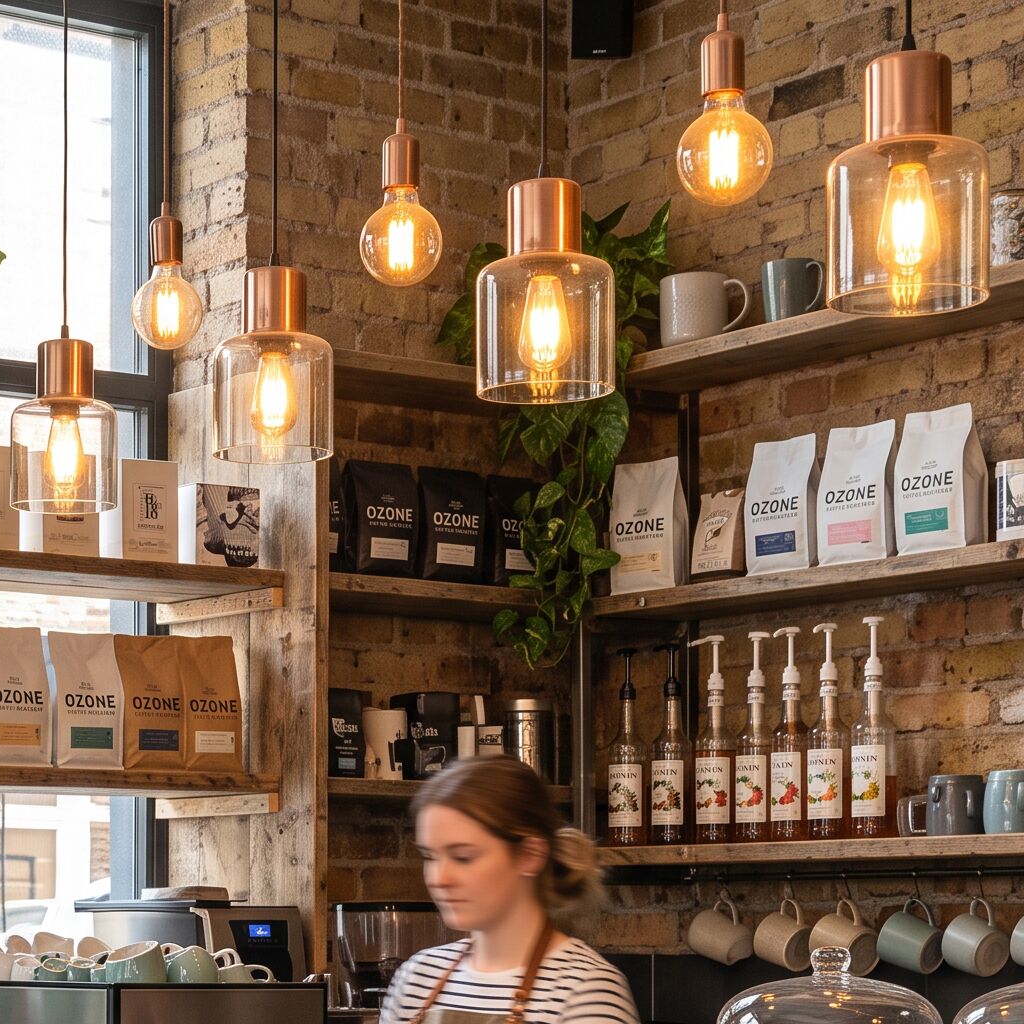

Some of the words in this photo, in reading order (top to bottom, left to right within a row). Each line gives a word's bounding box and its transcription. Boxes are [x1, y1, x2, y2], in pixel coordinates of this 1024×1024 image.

[901, 471, 953, 492] OZONE
[825, 484, 876, 504] OZONE
[367, 505, 413, 522] OZONE
[751, 496, 799, 516] OZONE
[433, 511, 480, 528] OZONE
[615, 517, 665, 536] OZONE
[65, 694, 116, 708] OZONE
[132, 696, 181, 711] OZONE
[190, 699, 238, 713] OZONE
